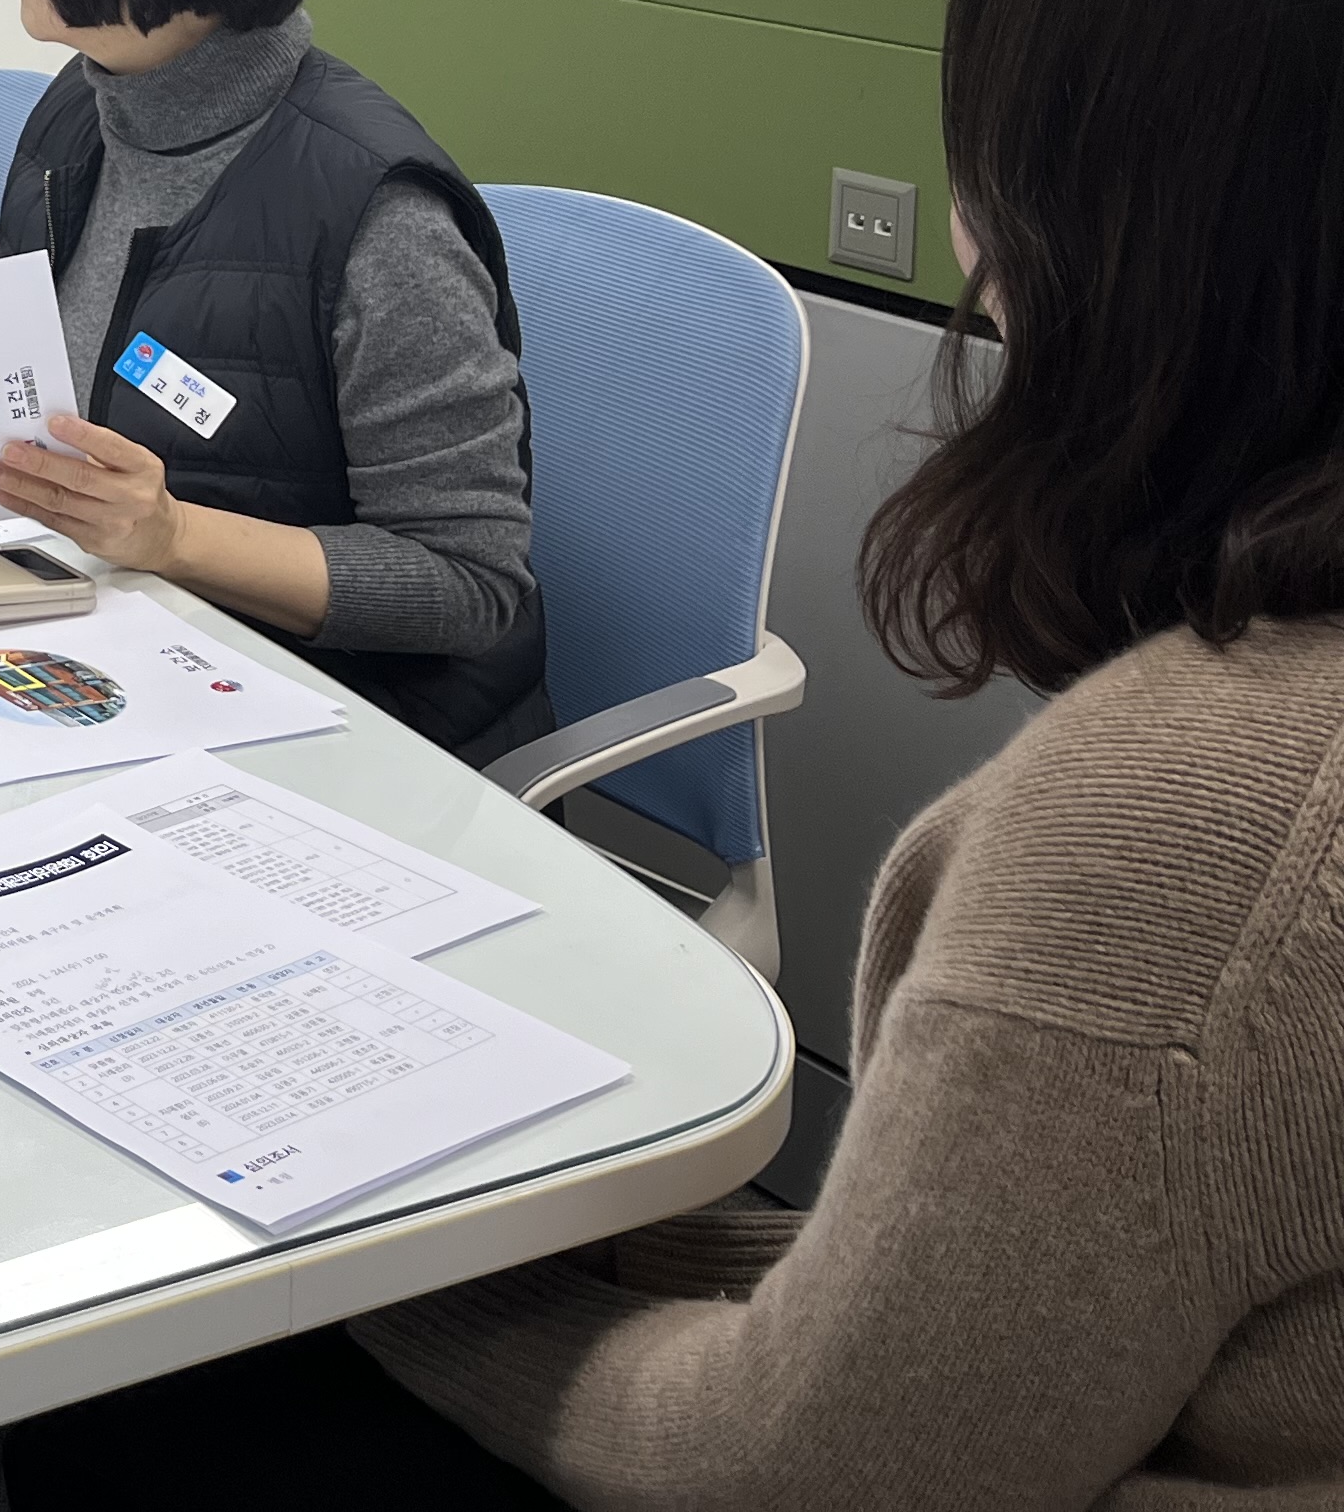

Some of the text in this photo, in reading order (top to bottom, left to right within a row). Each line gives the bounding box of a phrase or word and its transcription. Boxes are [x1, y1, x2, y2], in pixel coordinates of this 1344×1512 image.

[179, 374, 206, 398] 보건소
[150, 377, 211, 426] 고미정
[80, 841, 120, 861] 회의
[244, 1145, 301, 1172] 심의조서
